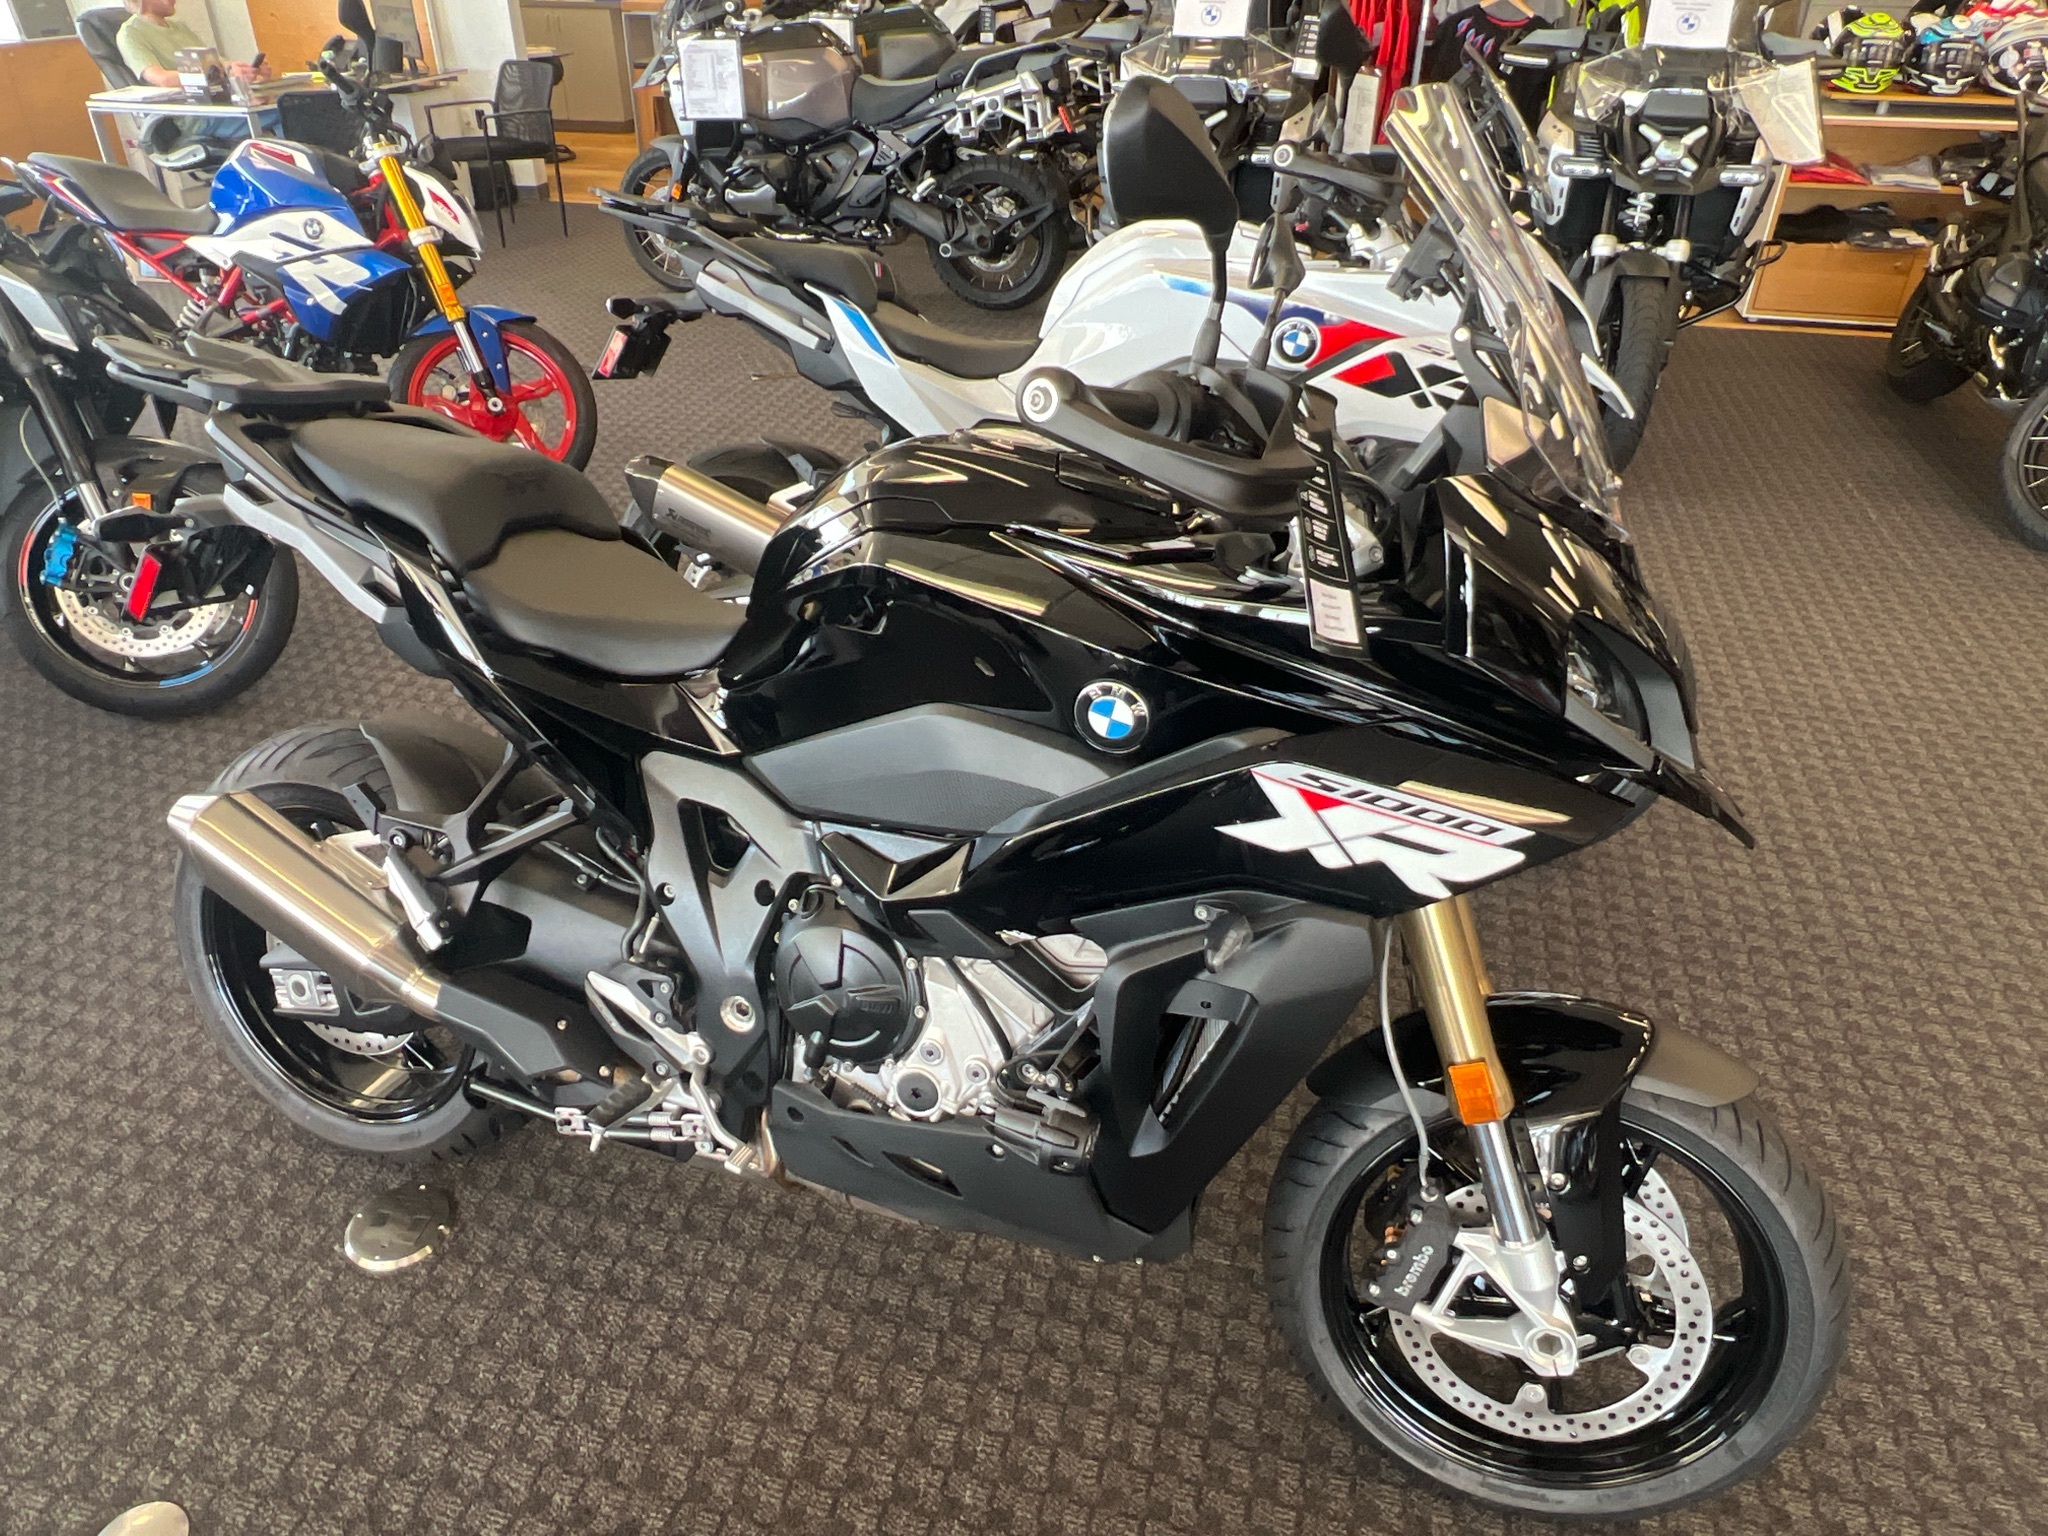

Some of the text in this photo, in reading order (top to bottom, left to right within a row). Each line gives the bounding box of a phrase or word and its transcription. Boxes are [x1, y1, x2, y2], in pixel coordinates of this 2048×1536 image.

[1087, 685, 1146, 717] BMW
[1213, 770, 1526, 899] XR
[1394, 1245, 1434, 1297] brembo
